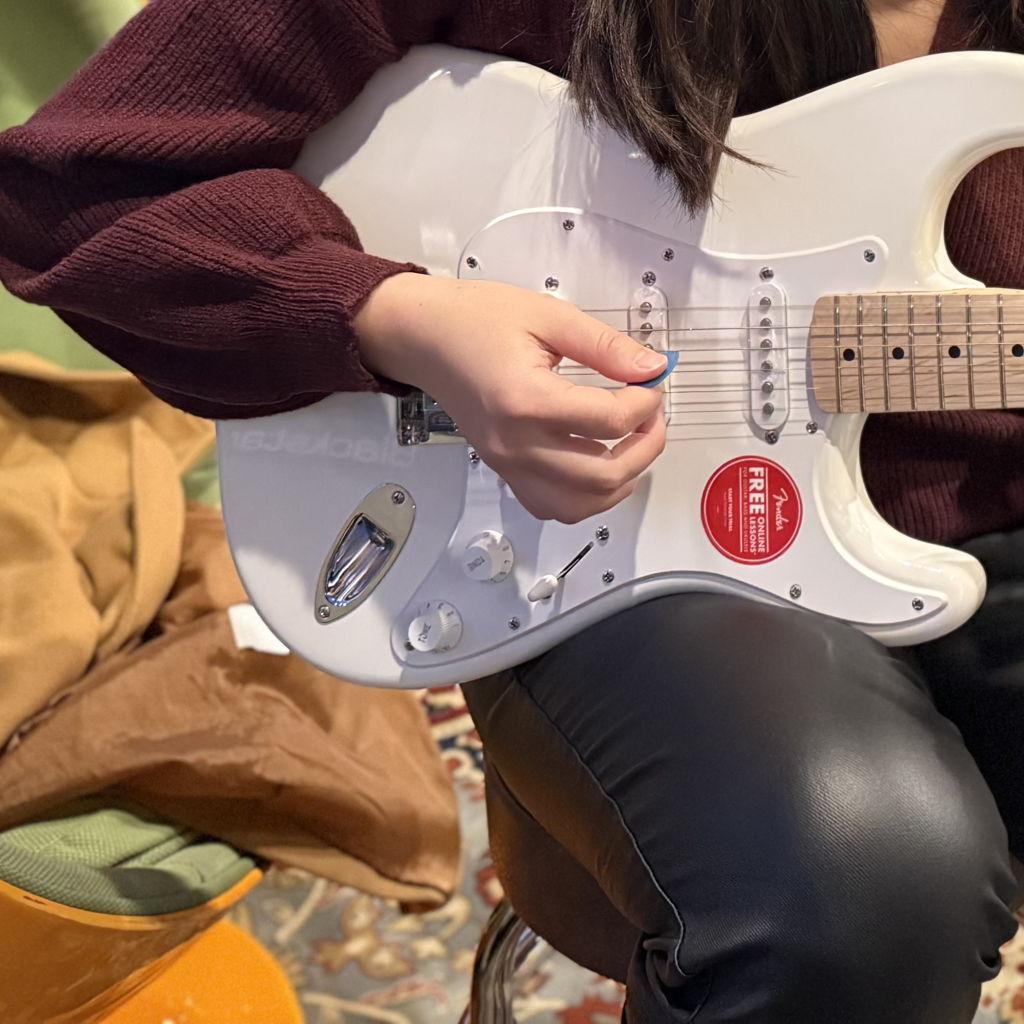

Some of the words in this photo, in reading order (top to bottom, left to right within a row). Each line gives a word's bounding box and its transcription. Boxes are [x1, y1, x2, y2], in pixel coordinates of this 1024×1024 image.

[748, 467, 765, 515] FREE
[773, 487, 789, 531] Fender
[757, 516, 766, 553] ONLINE
